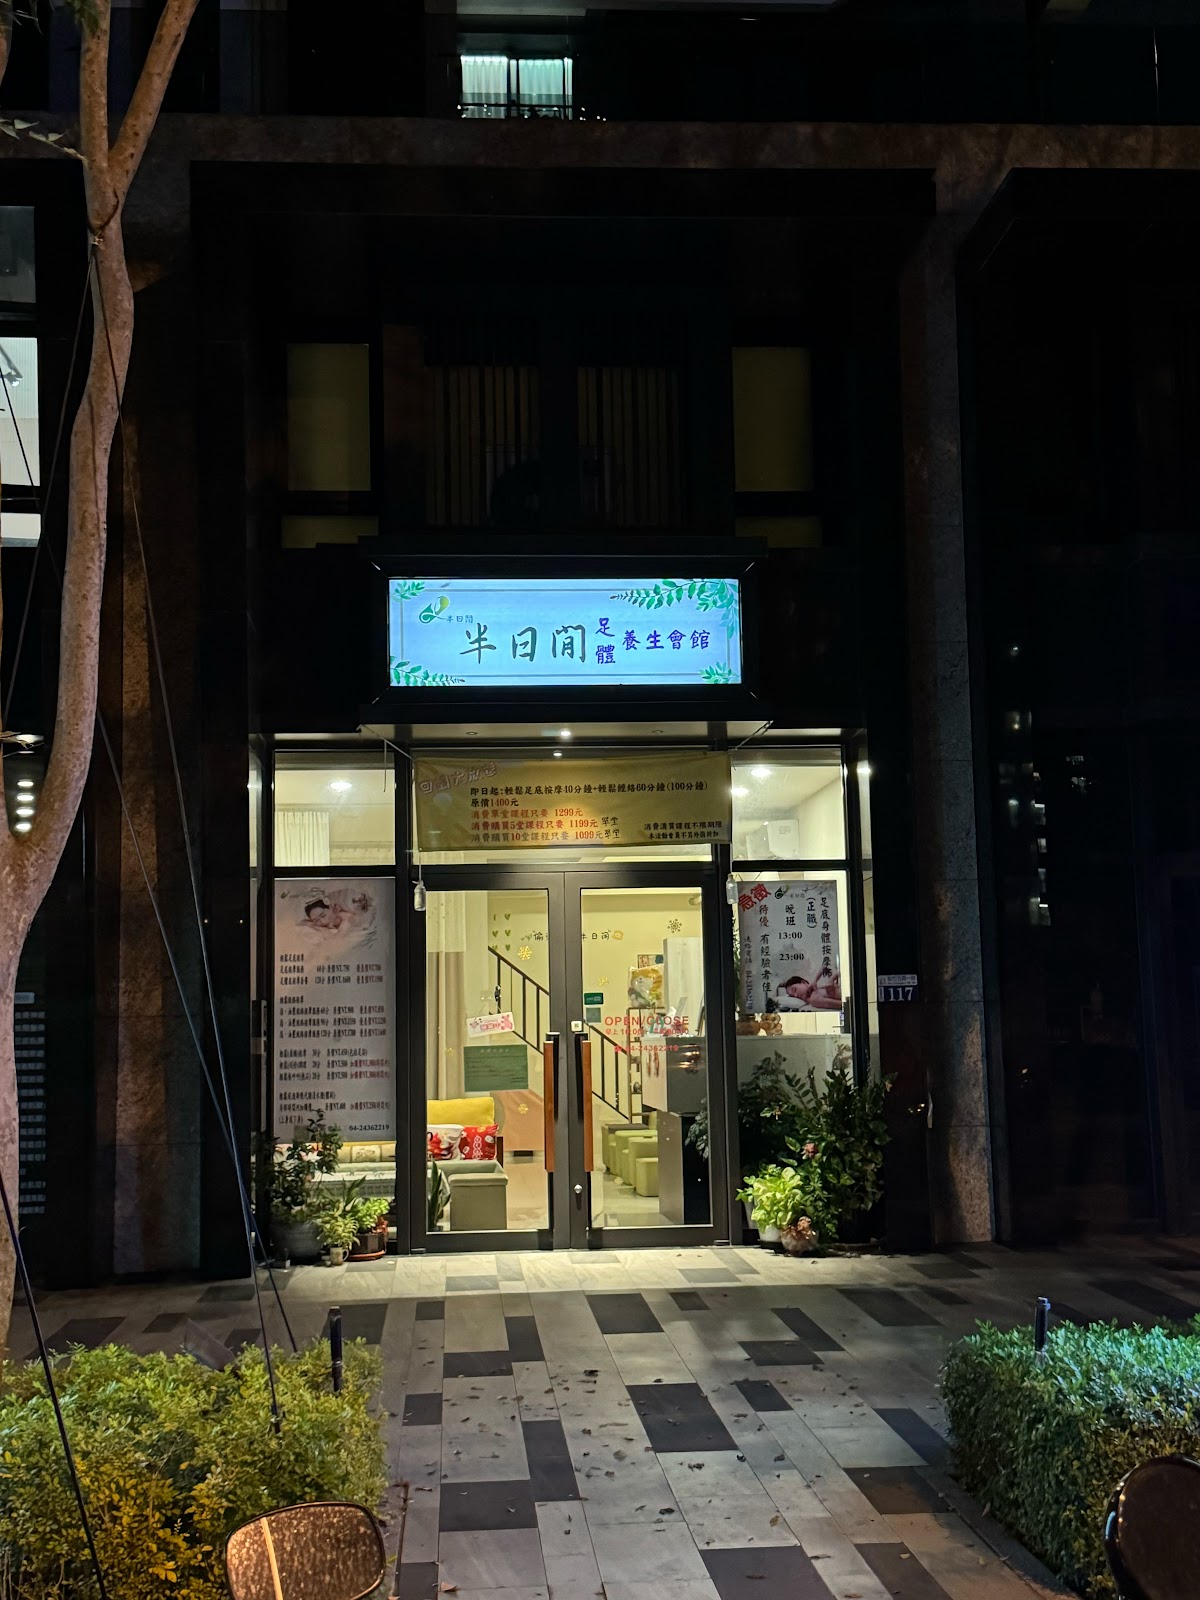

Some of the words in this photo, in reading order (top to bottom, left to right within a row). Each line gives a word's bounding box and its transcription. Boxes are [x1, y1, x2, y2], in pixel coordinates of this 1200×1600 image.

[622, 629, 711, 651] 養生會館
[470, 798, 519, 808] 原價1400元
[554, 807, 584, 818] 1299元
[569, 818, 598, 829] 1199元
[574, 830, 604, 841] 1099元
[785, 904, 796, 926] 晚班
[778, 931, 803, 940] 13:00
[760, 933, 772, 992] 有經驗者佳
[779, 953, 805, 961] 23:00
[888, 987, 913, 1002] 117
[604, 1016, 689, 1026] OPEN/CLOSE
[348, 1124, 390, 1132] 04-24362219
